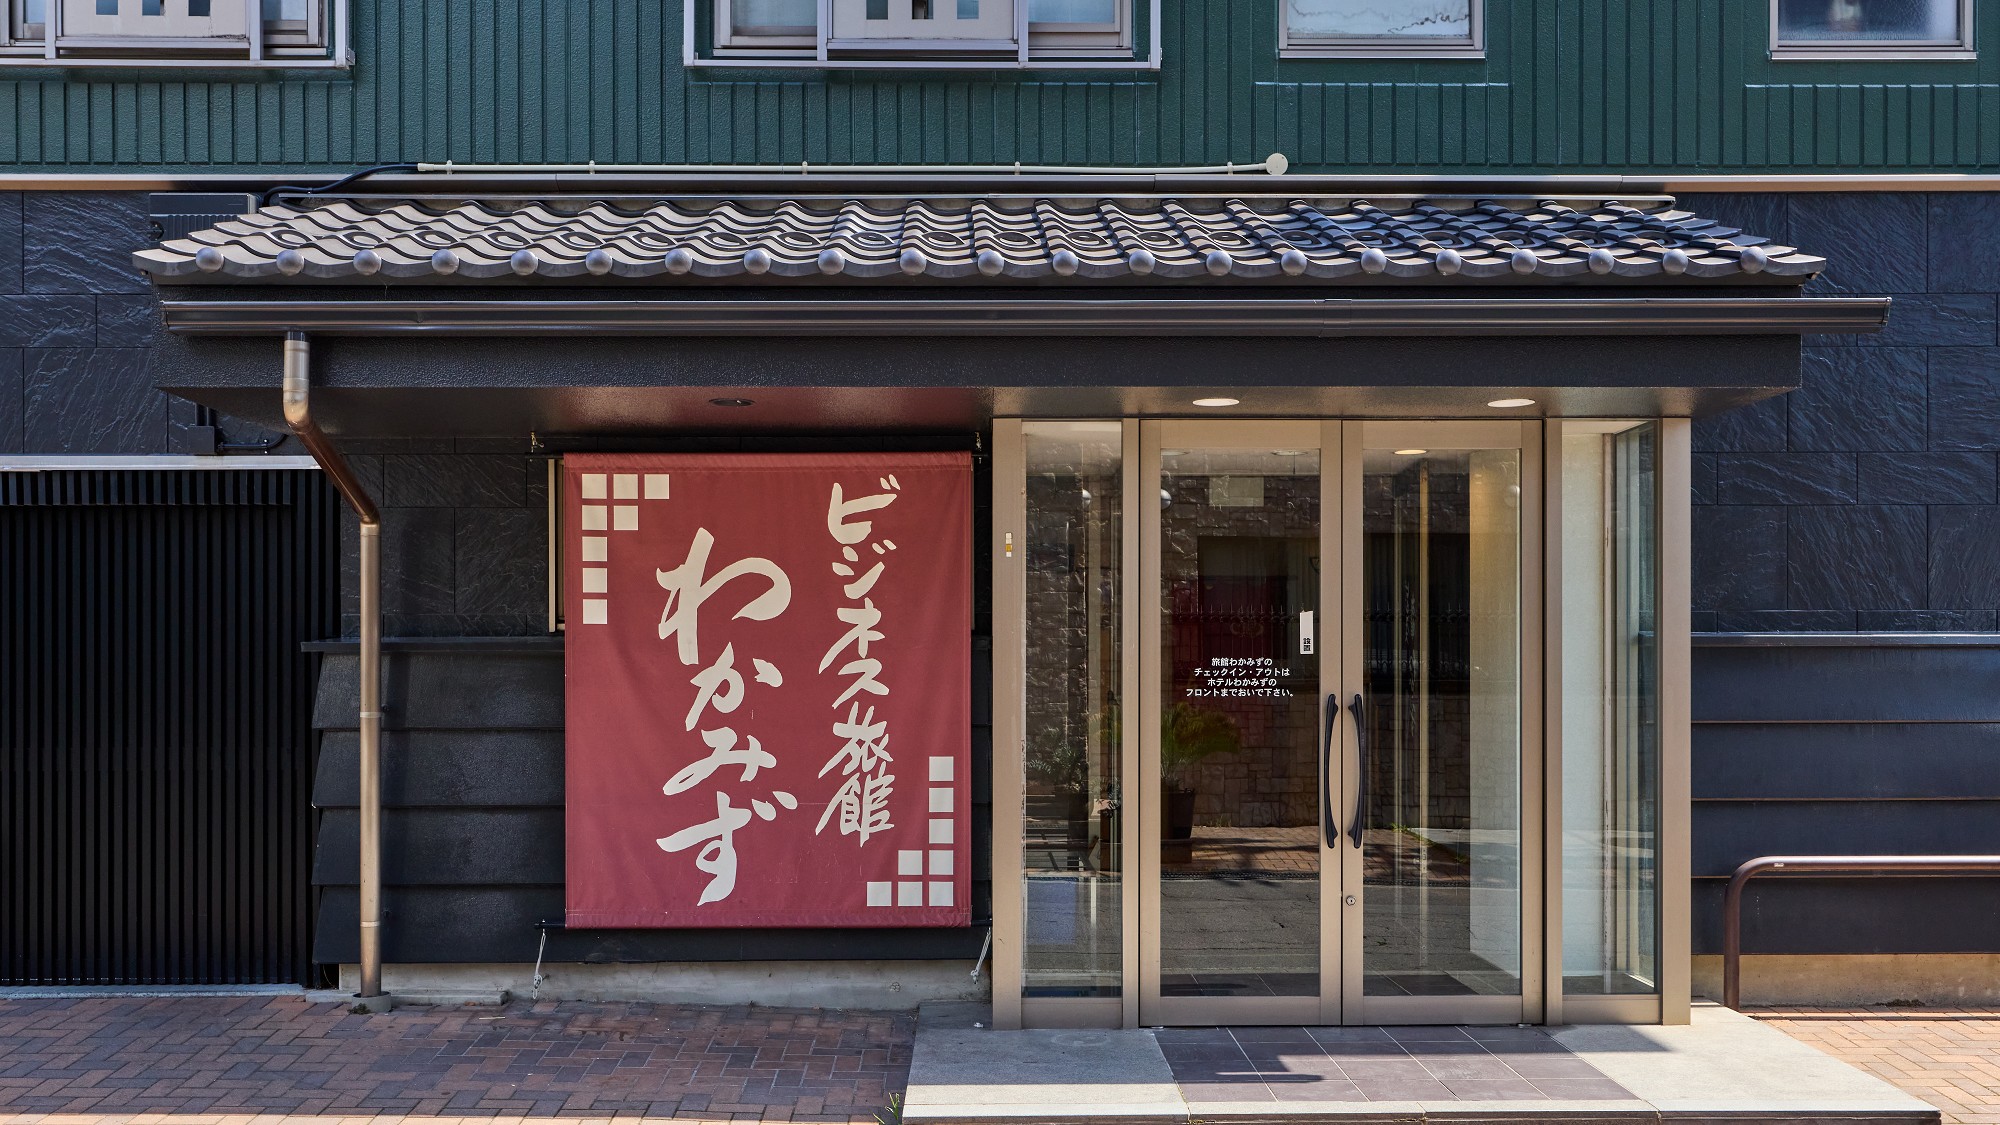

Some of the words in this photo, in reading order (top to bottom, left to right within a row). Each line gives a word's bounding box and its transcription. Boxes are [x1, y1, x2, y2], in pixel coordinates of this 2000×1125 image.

[815, 474, 900, 847] ビジネス旅館
[1211, 657, 1273, 667] 旅館わかみずの
[1193, 667, 1291, 677] チェックイン・アウトは
[1207, 677, 1277, 687] ホテルわかみずの
[1186, 687, 1294, 698] フロントまでおいで下さい。
[656, 527, 798, 906] わかみず
